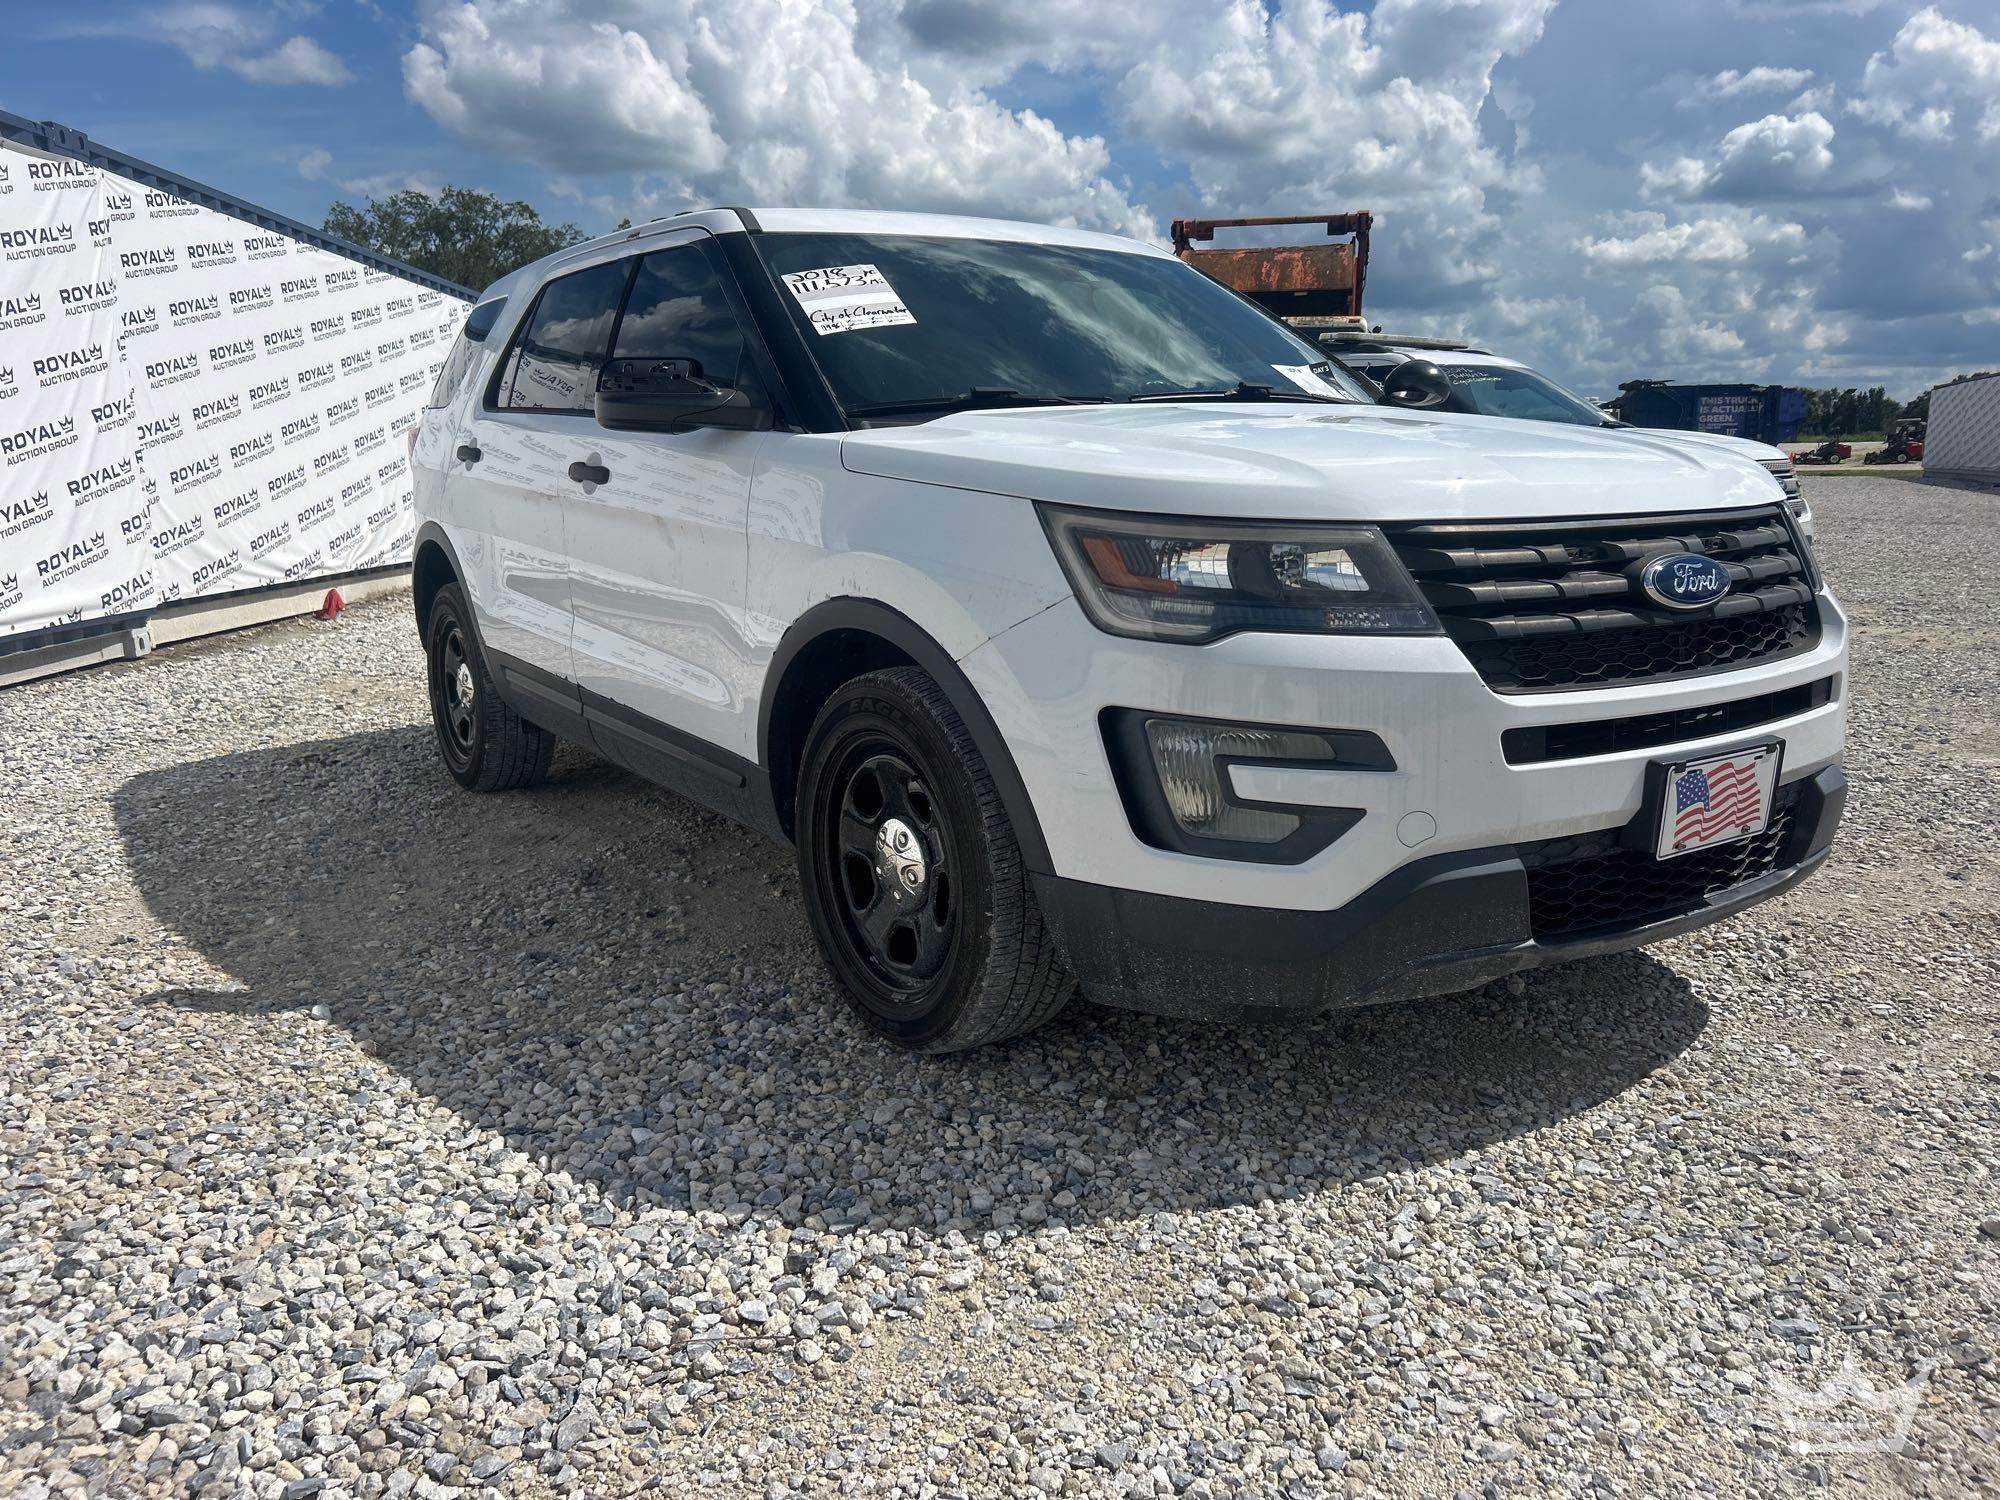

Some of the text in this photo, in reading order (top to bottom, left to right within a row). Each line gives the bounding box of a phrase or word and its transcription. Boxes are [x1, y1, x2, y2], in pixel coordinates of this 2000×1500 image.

[28, 161, 84, 179] ROYAL
[33, 179, 97, 192] AUCTION GROUP
[110, 212, 135, 222] GROUP
[150, 208, 199, 219] AUCTION GROUP
[0, 226, 59, 248] ROYAL
[244, 237, 276, 251] ROYAL
[6, 243, 77, 261] AUCTION GROUP
[120, 250, 165, 267] ROYAL
[187, 242, 225, 258] ROYAL
[125, 264, 178, 279] AUCTION GROUP
[191, 256, 237, 269] AUCTION GROUP
[281, 279, 310, 294] ROYAL
[325, 270, 351, 285] ROYAL
[59, 281, 110, 304] ROYAL
[229, 287, 263, 304] ROYAL
[65, 304, 100, 317] AUCTION
[169, 298, 209, 316] ROYAL
[810, 310, 835, 324] City
[839, 309, 850, 319] of
[14, 314, 45, 327] GROUP
[121, 310, 145, 326] YAL
[173, 311, 221, 327] AUCTION GROUP
[311, 316, 338, 334] ROYAL
[135, 324, 159, 336] GROUP
[264, 328, 295, 347] ROYAL
[439, 323, 451, 334] ROY
[209, 341, 245, 361] ROYAL
[341, 352, 365, 369] ROYAL
[33, 350, 91, 376] ROYAL
[146, 357, 188, 379] ROYAL
[1313, 366, 1324, 374] DAY
[39, 362, 108, 388] AUCTION GROUP
[150, 370, 200, 390] AUCTION GROUP
[298, 366, 327, 384] ROYAL
[0, 387, 19, 399] OUP
[249, 381, 281, 401] ROYAL
[192, 398, 230, 421] ROYAL
[327, 399, 353, 418] ROYAL
[196, 409, 242, 431] AUCTION GROUP
[281, 417, 312, 438] ROYAL
[0, 422, 62, 454] ROYAL
[161, 430, 184, 444] GROUP
[7, 435, 79, 467] AUCTION GROUP
[230, 436, 266, 459] ROYAL
[313, 449, 342, 470] ROYAL
[67, 464, 121, 497] ROYAL
[170, 459, 211, 485] ROYAL
[174, 469, 222, 495] AUCTION GROUP
[268, 469, 298, 493] ROYAL
[74, 475, 136, 508] AUCTION GROUP
[341, 480, 366, 500] ROYAL
[0, 499, 35, 524] YAL
[213, 493, 250, 520] ROYAL
[217, 502, 261, 529] AUCTION GROUP
[298, 502, 327, 524] ROYAL
[0, 510, 54, 539] TION GROUP
[151, 521, 193, 549] ROYAL
[154, 530, 205, 560] AUCTION GROUP
[250, 528, 282, 552] ROYAL
[36, 540, 93, 577] ROYAL
[42, 549, 109, 589] AUCTION GROUP
[192, 556, 231, 585] ROYAL
[1673, 562, 1718, 594] Ford
[196, 564, 243, 595] AUCTION GROUP
[100, 573, 150, 609] ROYAL
[104, 597, 138, 617] AUCTION
[139, 587, 155, 600] GRO
